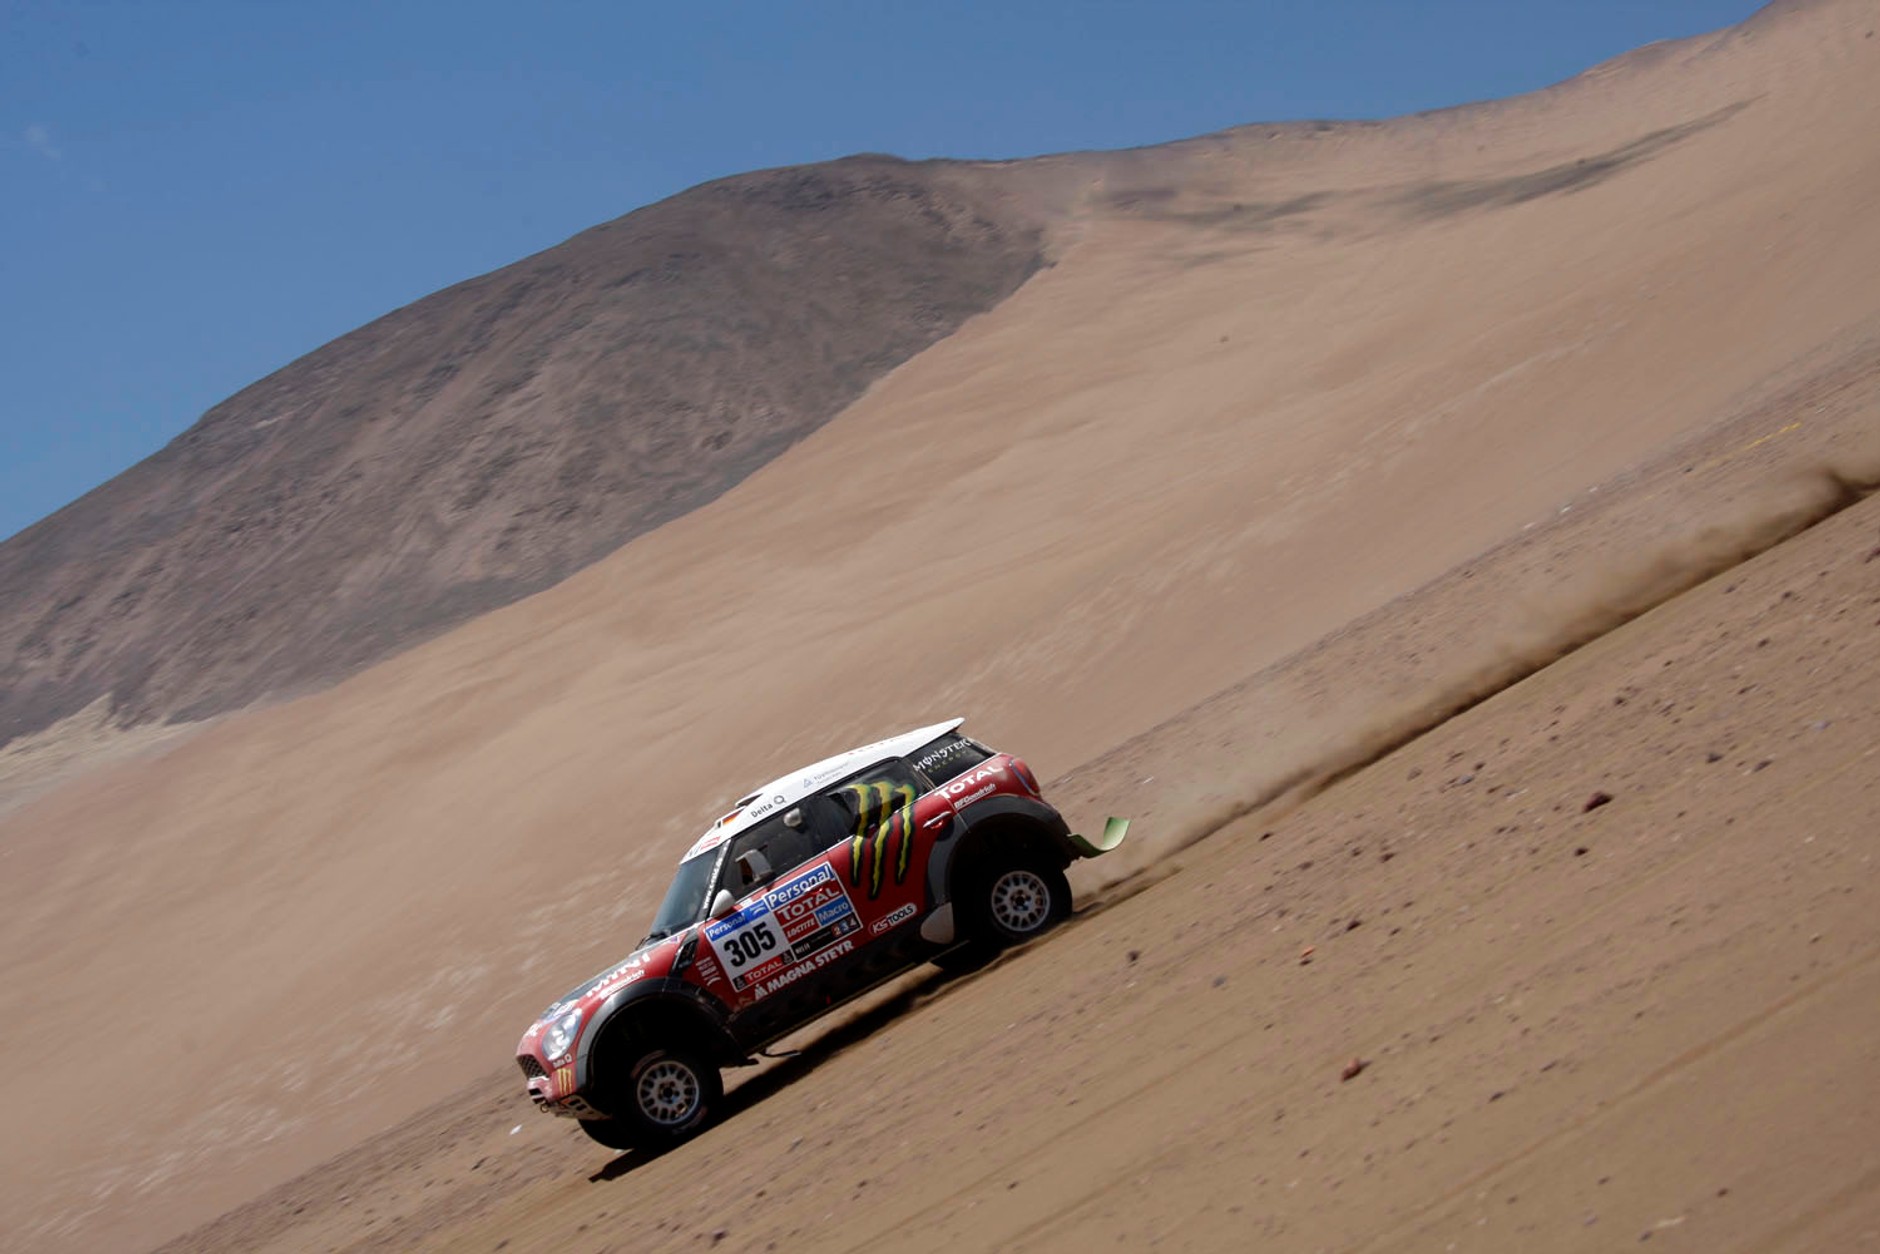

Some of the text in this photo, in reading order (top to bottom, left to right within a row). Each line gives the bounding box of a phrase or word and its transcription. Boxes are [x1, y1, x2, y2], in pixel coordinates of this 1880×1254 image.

[913, 738, 972, 772] MONSTER
[934, 764, 1004, 799] TOTAL
[751, 802, 774, 818] Delta
[767, 865, 833, 907] Personal
[778, 888, 840, 921] TOTAL
[818, 902, 849, 923] Macro
[887, 905, 914, 924] TOOLS
[708, 912, 746, 938] Personal
[724, 922, 776, 968] 305
[744, 960, 783, 981] TOTAL
[767, 940, 854, 993] MAGNA STEYR
